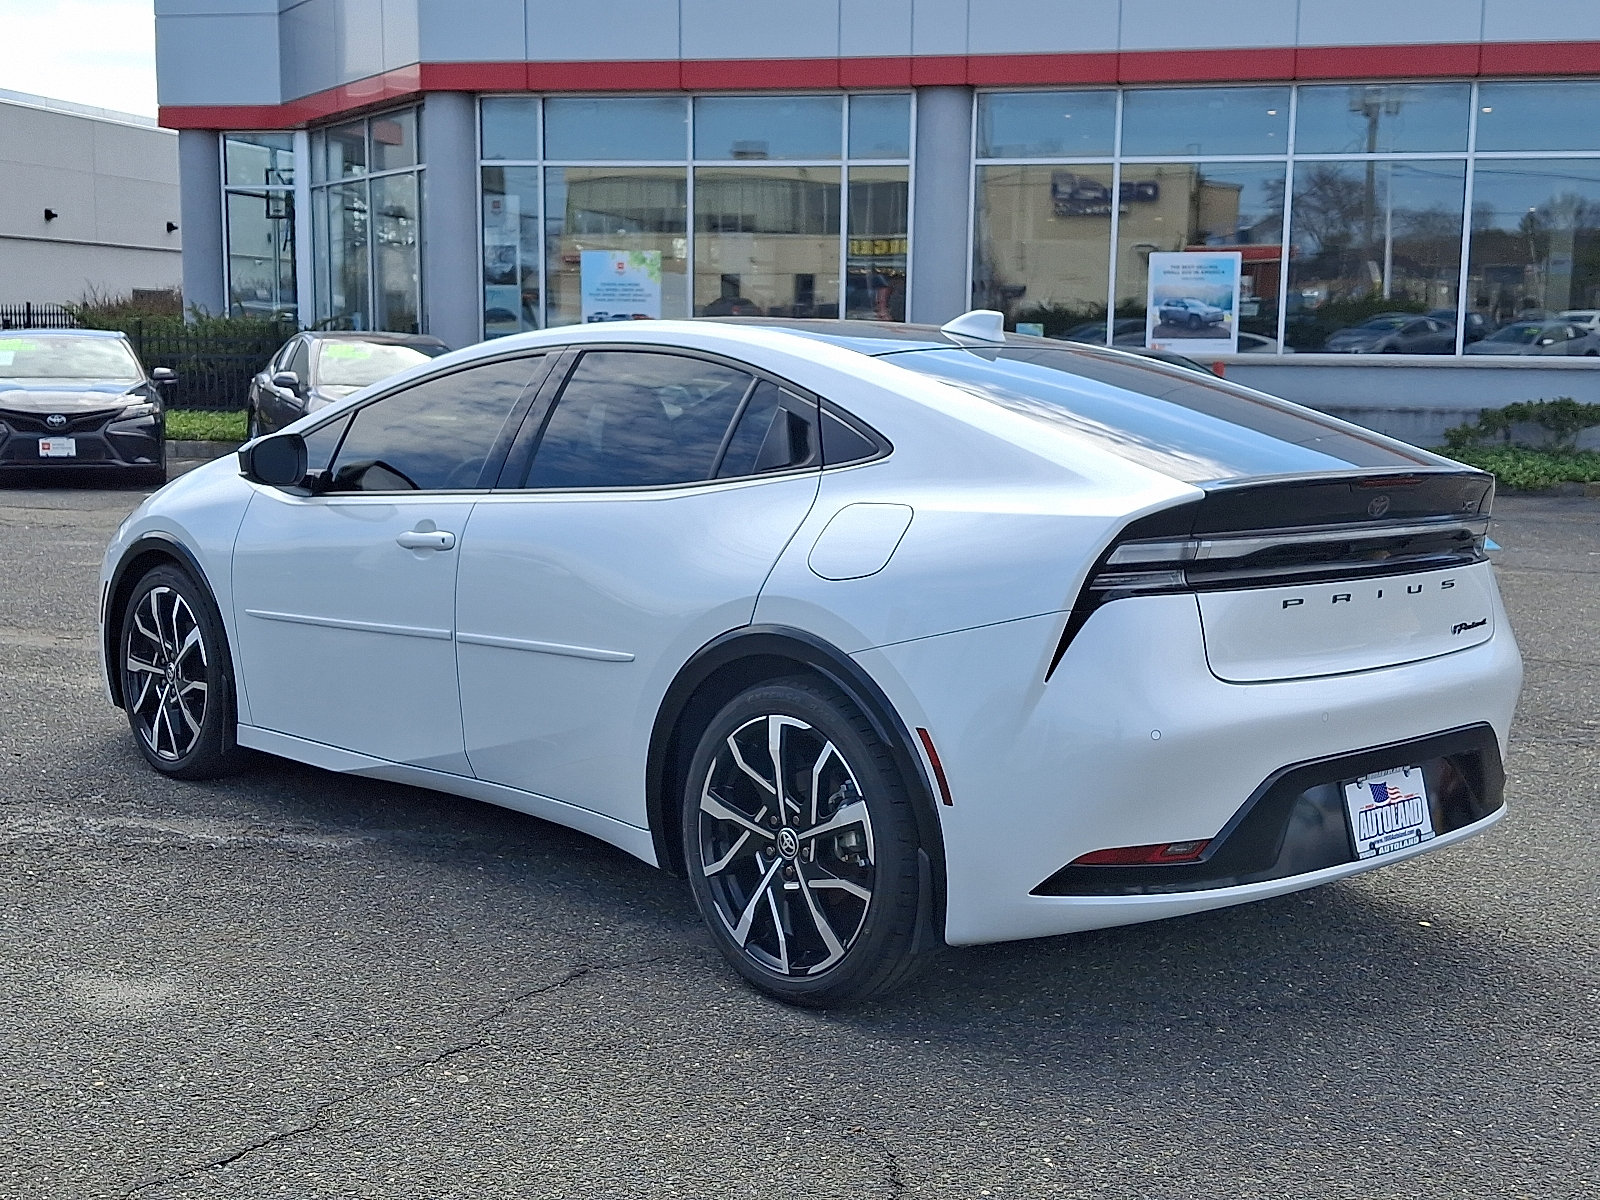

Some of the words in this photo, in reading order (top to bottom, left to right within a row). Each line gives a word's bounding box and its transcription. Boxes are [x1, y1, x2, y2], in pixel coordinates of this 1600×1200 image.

[1282, 579, 1456, 609] PRIUS
[1360, 798, 1422, 841] AUTOLAND
[1379, 836, 1420, 854] AUTOLAND
